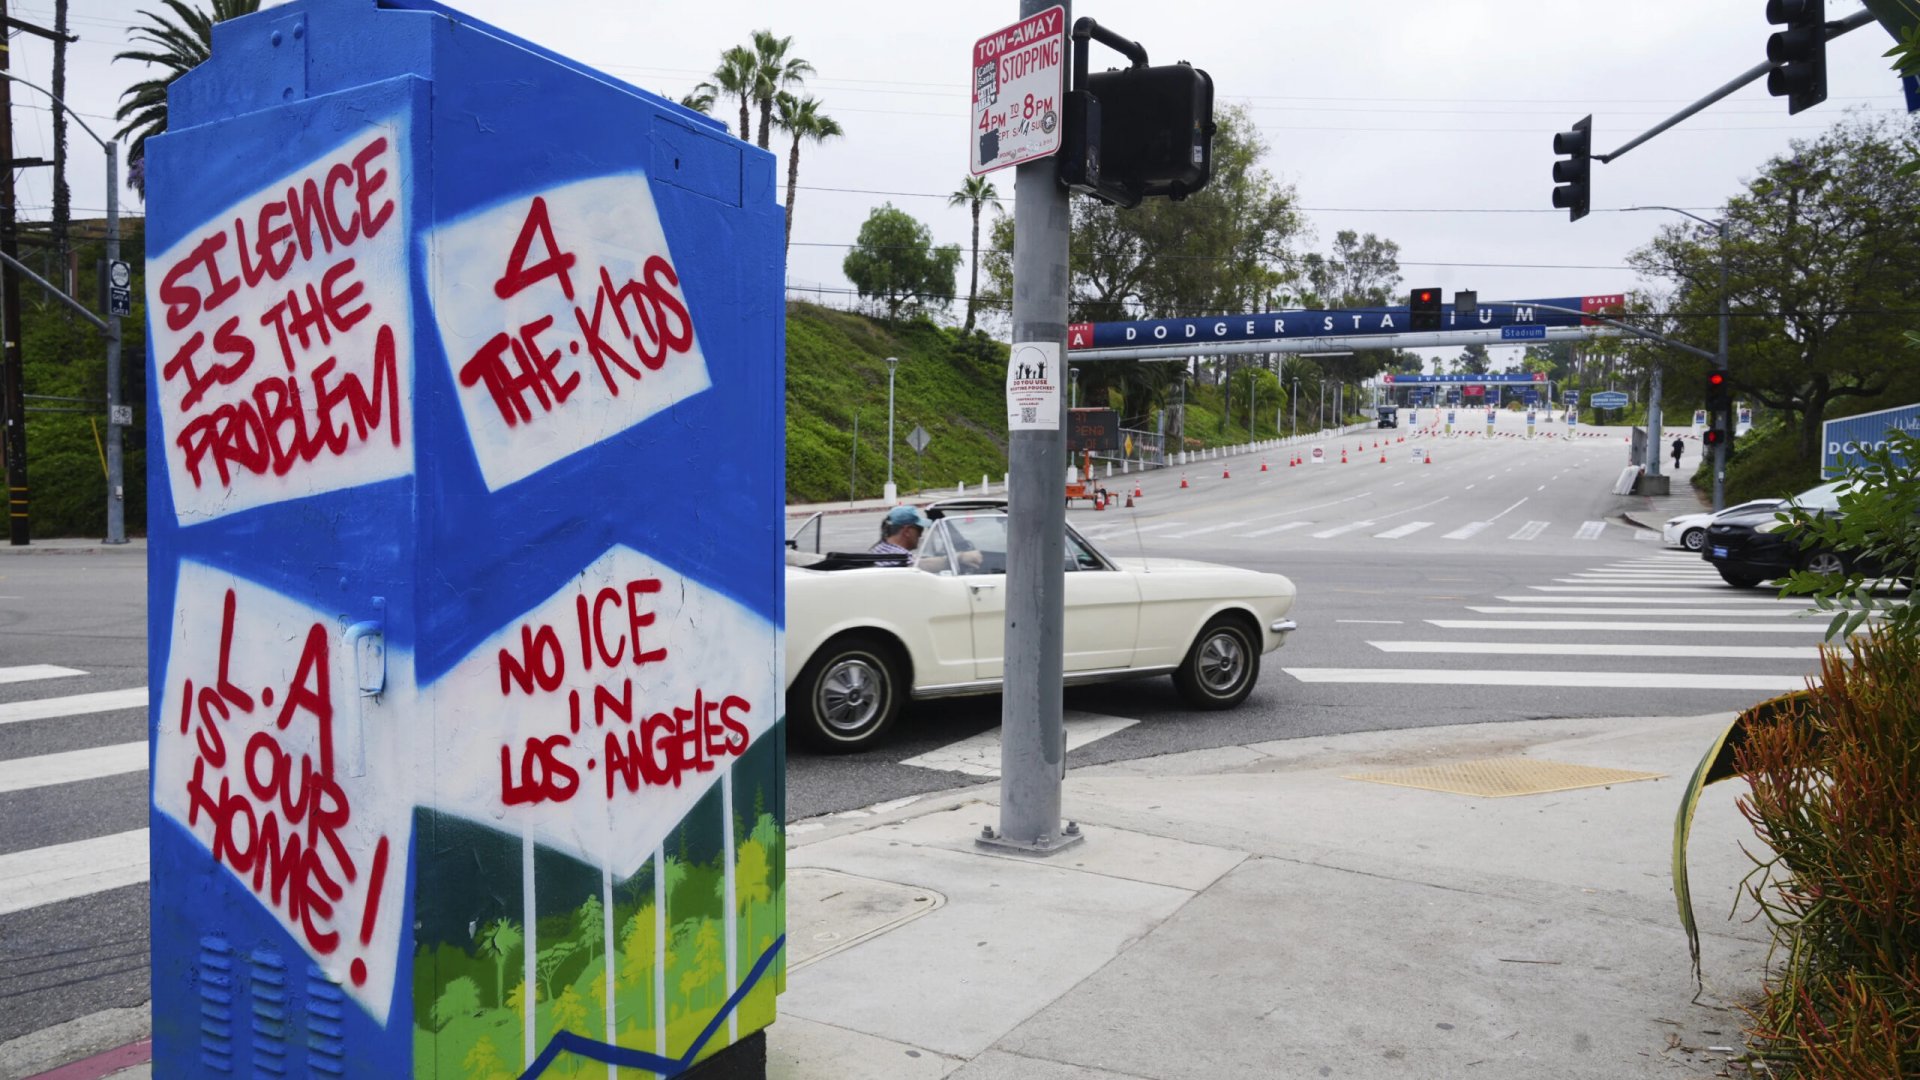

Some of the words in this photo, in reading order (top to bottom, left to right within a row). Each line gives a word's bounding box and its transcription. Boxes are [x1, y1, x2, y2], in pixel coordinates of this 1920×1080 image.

[978, 13, 1057, 60] TOW-AWAY
[1001, 38, 1059, 84] STOPPING
[1010, 103, 1019, 117] TO
[159, 136, 395, 331] SILENCE
[494, 196, 576, 301] 4
[163, 315, 255, 412] IS
[260, 257, 372, 373] THE
[459, 314, 581, 428] THE
[1073, 333, 1084, 346] A
[1126, 319, 1285, 341] DODGER
[1323, 307, 1534, 330] STAIUM
[1505, 328, 1543, 338] Stadium
[176, 324, 401, 488] PROBLEM
[498, 623, 565, 696] NO
[576, 579, 668, 672] ICE
[501, 734, 580, 806] LOS
[604, 688, 751, 800] ANGELES
[569, 677, 633, 734] IN
[245, 732, 358, 884] OUR
